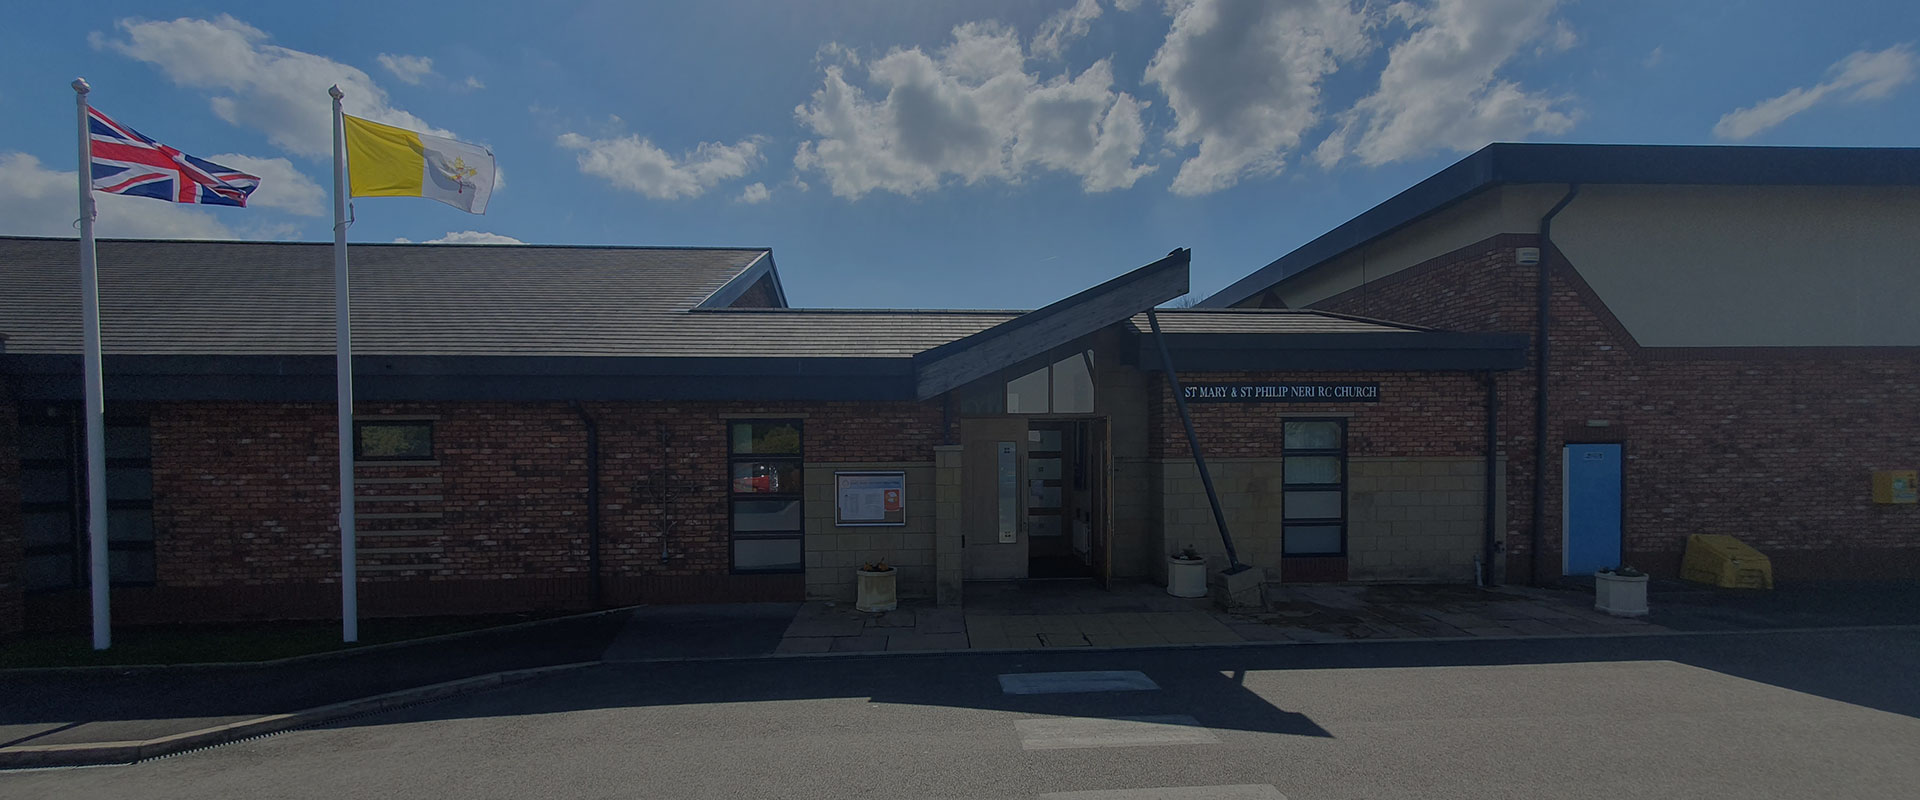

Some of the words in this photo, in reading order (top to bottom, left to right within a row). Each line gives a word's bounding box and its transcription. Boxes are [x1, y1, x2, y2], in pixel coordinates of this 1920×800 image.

[1185, 386, 1197, 398] ST
[1200, 386, 1228, 398] MARY
[1231, 386, 1238, 398] &
[1240, 386, 1253, 398] ST
[1255, 386, 1288, 398] PHILIP
[1291, 386, 1315, 398] NERI
[1318, 386, 1333, 398] RC
[1334, 386, 1377, 398] CHURCH
